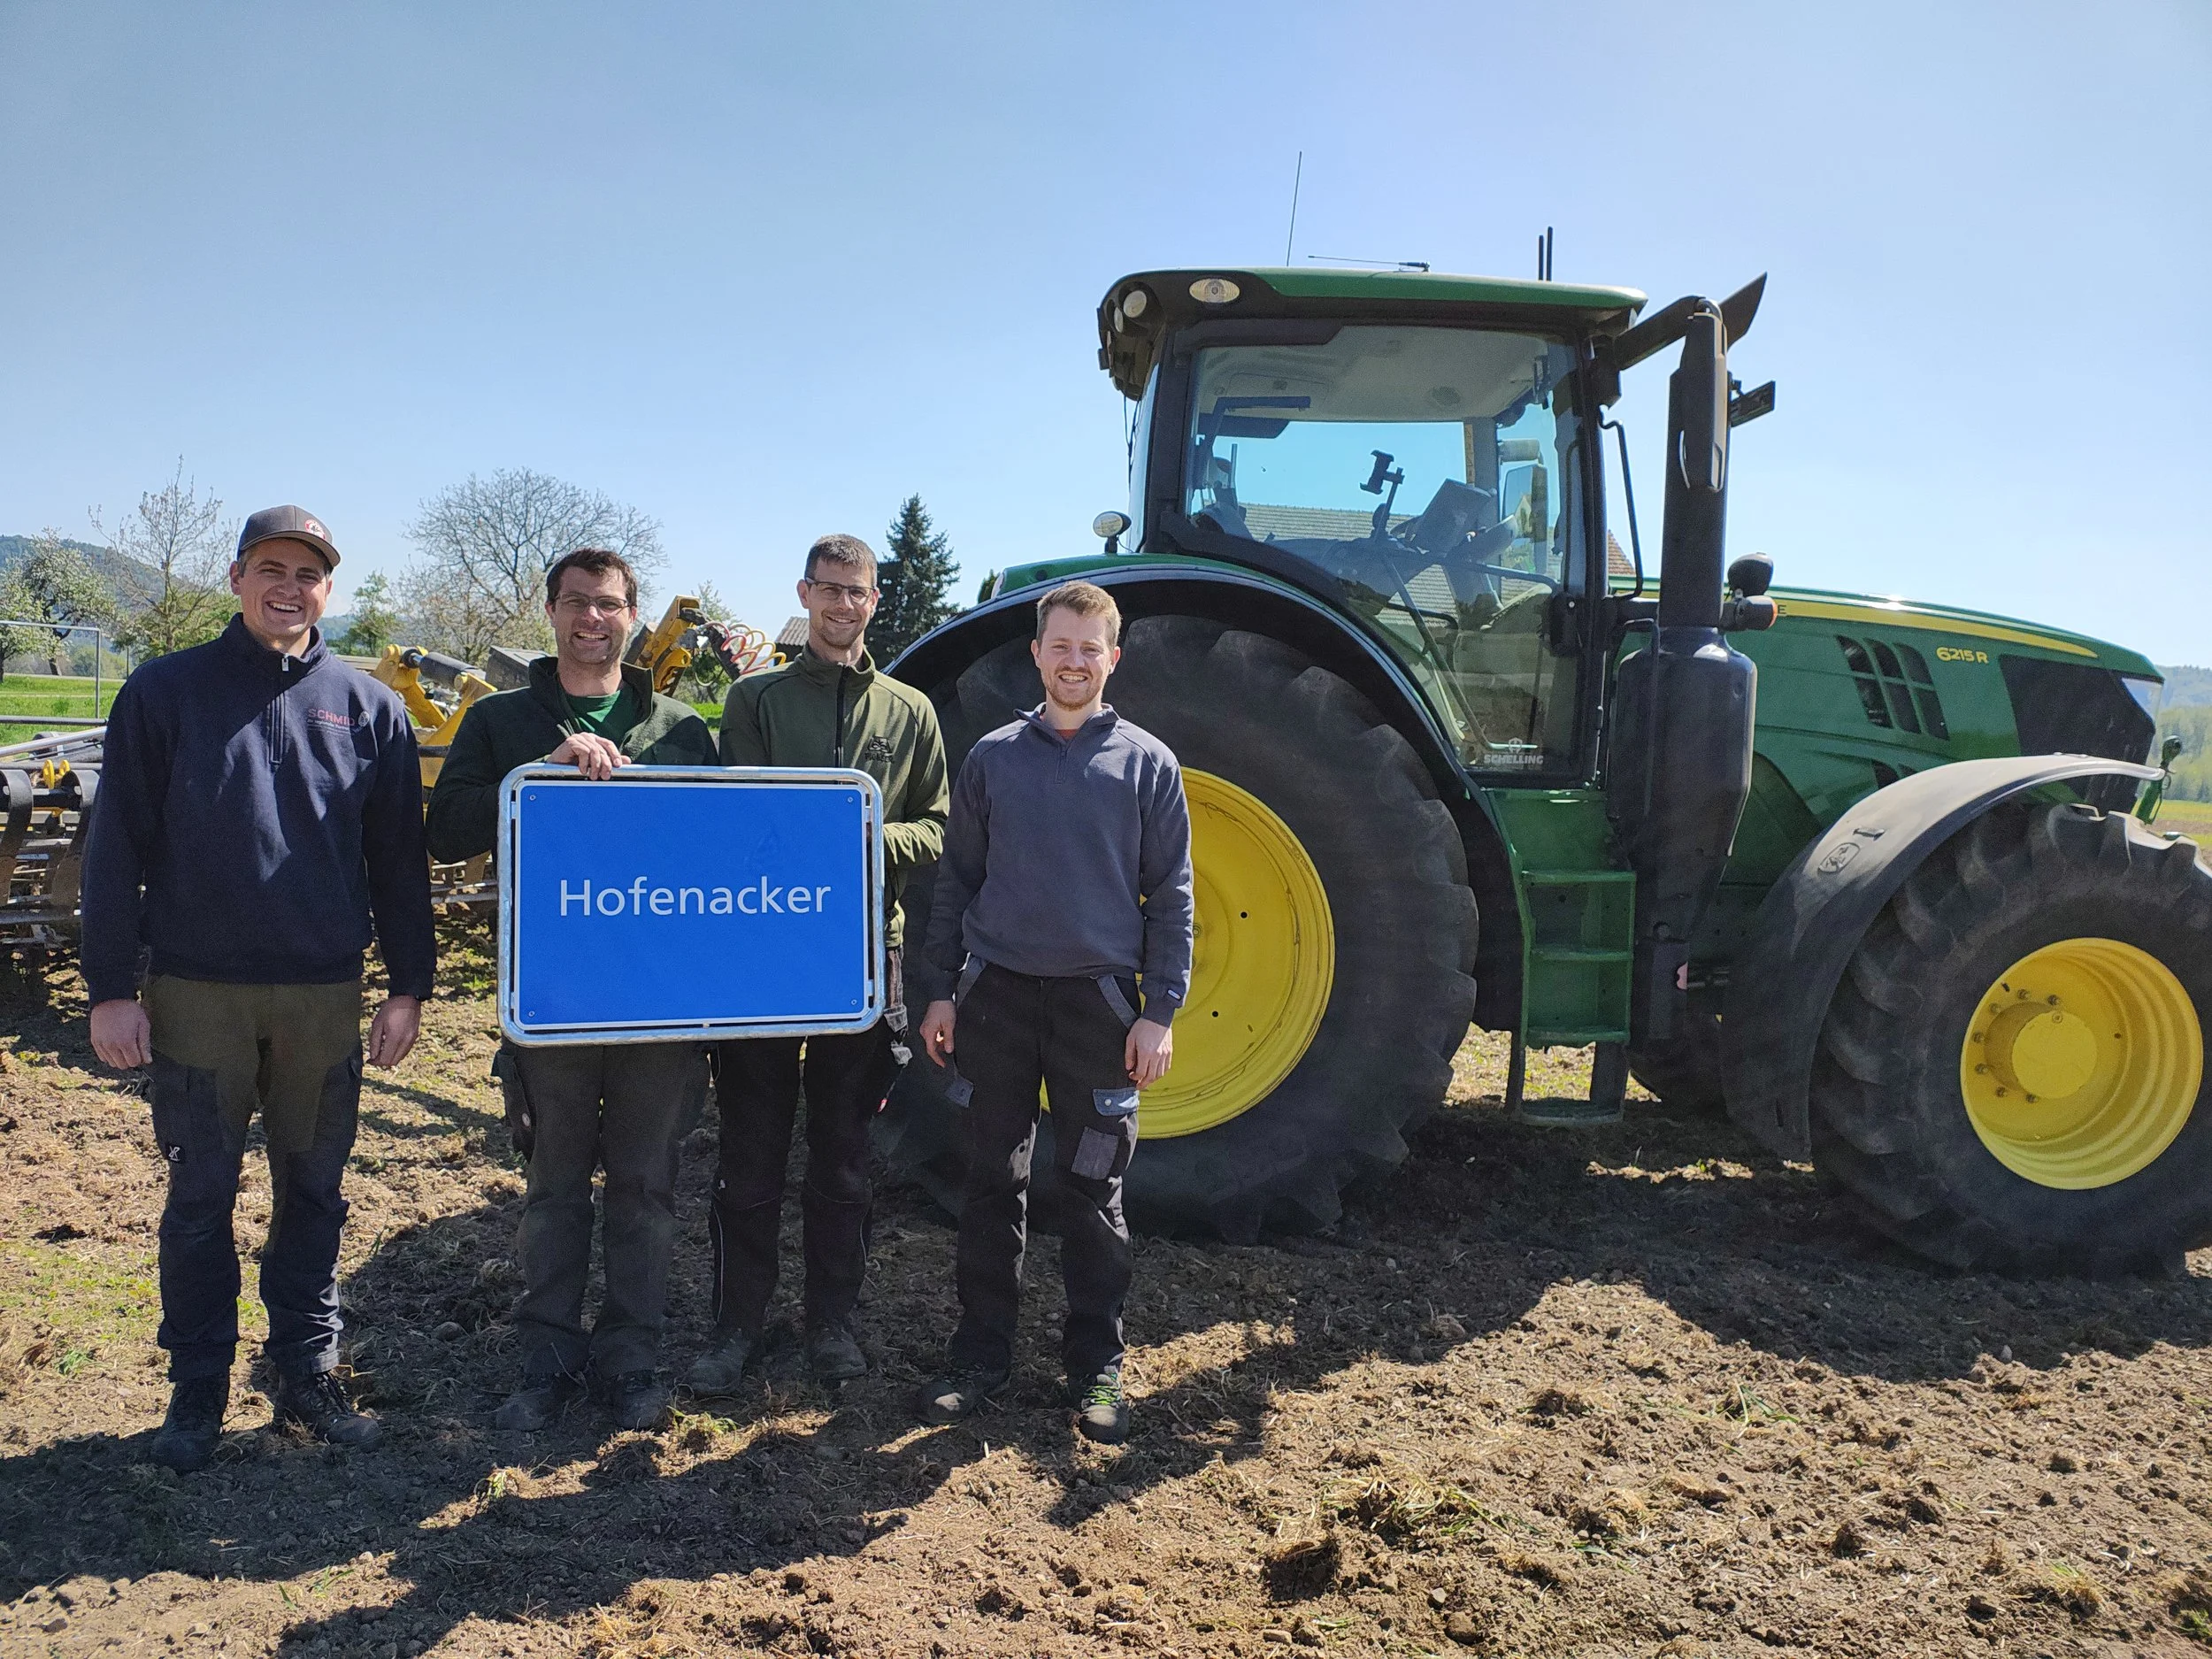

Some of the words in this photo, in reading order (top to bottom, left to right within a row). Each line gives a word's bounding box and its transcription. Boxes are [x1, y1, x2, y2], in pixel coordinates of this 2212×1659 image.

[1936, 646, 1975, 663] 6215
[1975, 650, 1989, 664] R
[307, 708, 355, 726] SCHMID
[1484, 754, 1544, 765] SCHELLING
[560, 876, 832, 916] Hofenacker
